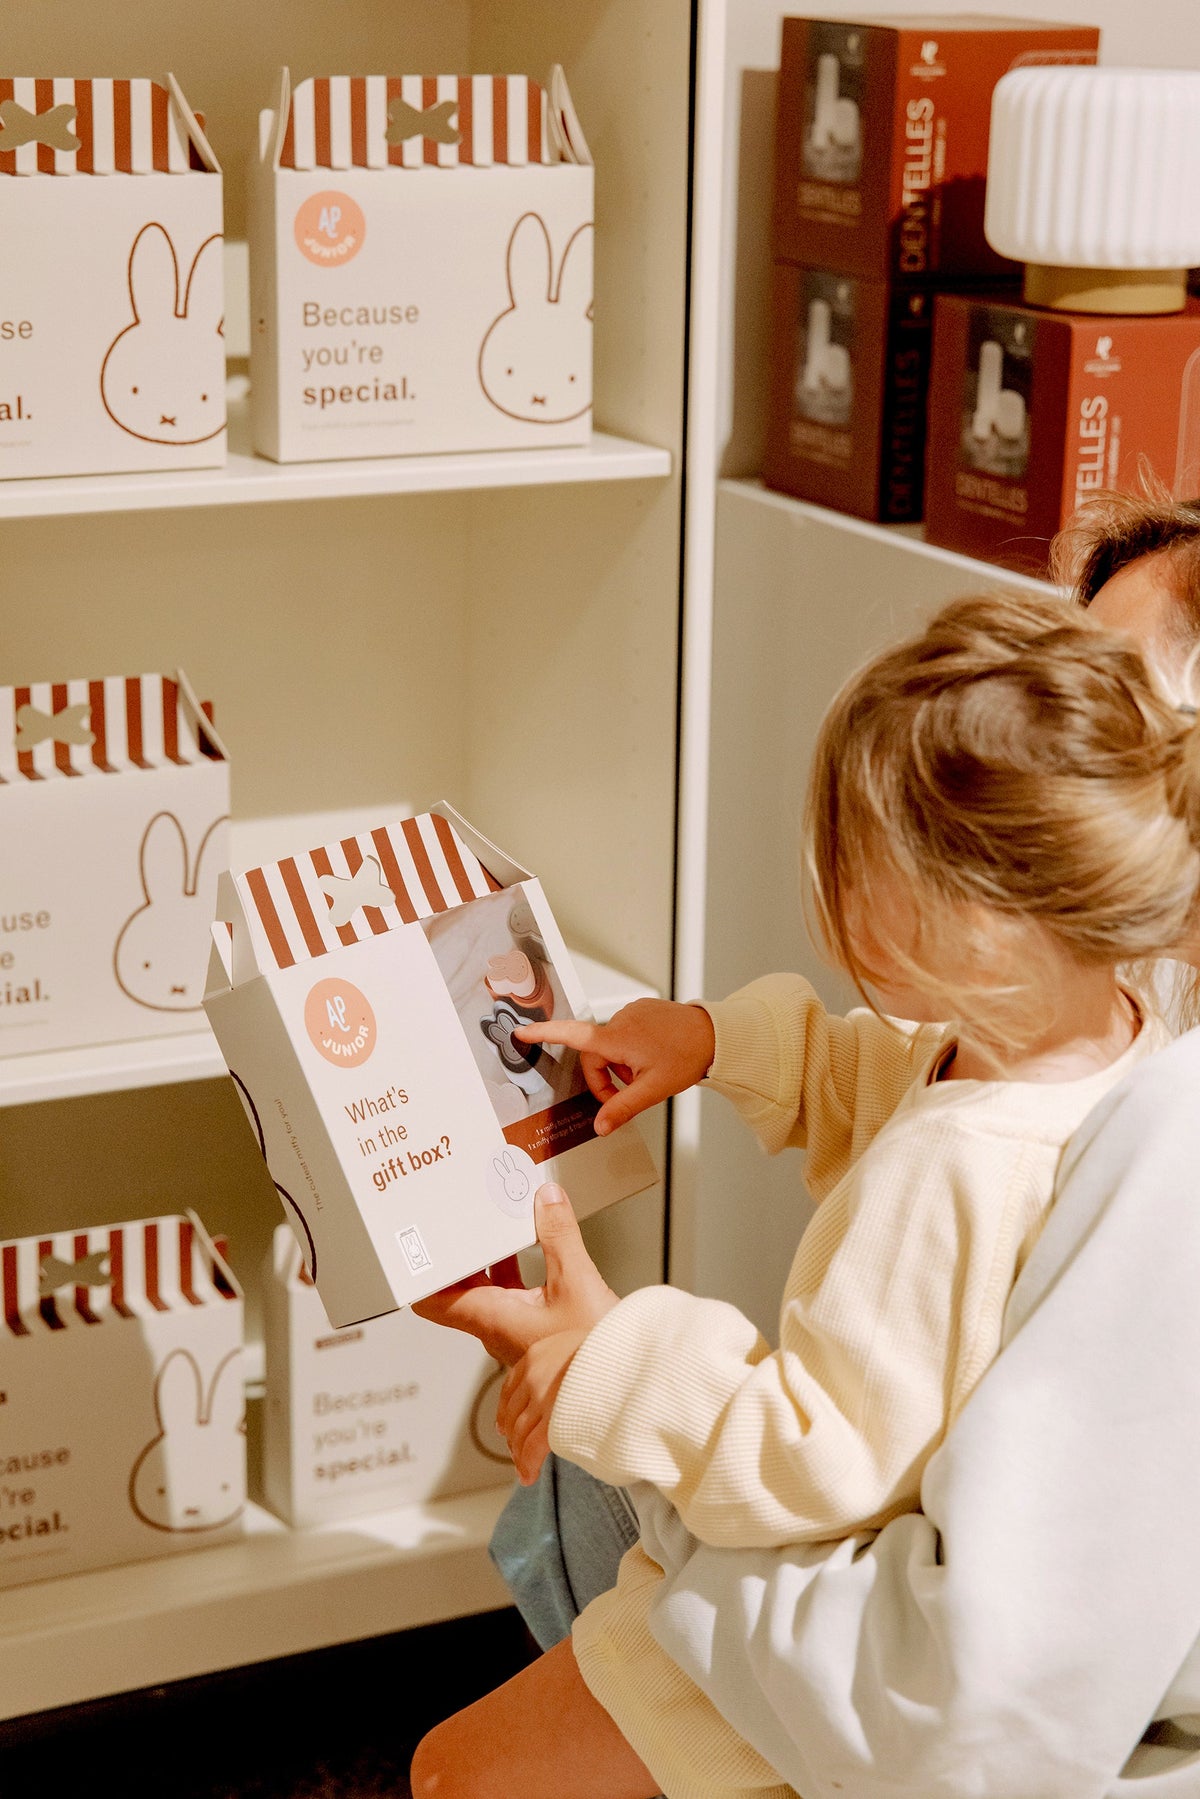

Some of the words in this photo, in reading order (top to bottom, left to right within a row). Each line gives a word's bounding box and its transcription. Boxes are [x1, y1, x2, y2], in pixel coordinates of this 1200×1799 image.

[900, 97, 935, 273] DENTELLES
[303, 234, 356, 258] JUNIOR
[303, 301, 420, 328] Because
[301, 339, 384, 373] you're
[303, 376, 416, 410] special.
[326, 995, 351, 1032] AP
[322, 1024, 369, 1057] JUNIOR
[274, 1098, 288, 1119] you!
[344, 1086, 409, 1124] What's
[284, 1121, 293, 1134] for
[357, 1137, 377, 1157] in
[378, 1125, 408, 1148] the
[291, 1136, 303, 1160] miffy
[372, 1156, 408, 1192] gift
[406, 1135, 452, 1172] box?
[300, 1161, 316, 1191] cutest
[313, 1193, 324, 1211] The
[313, 1383, 419, 1416] Because
